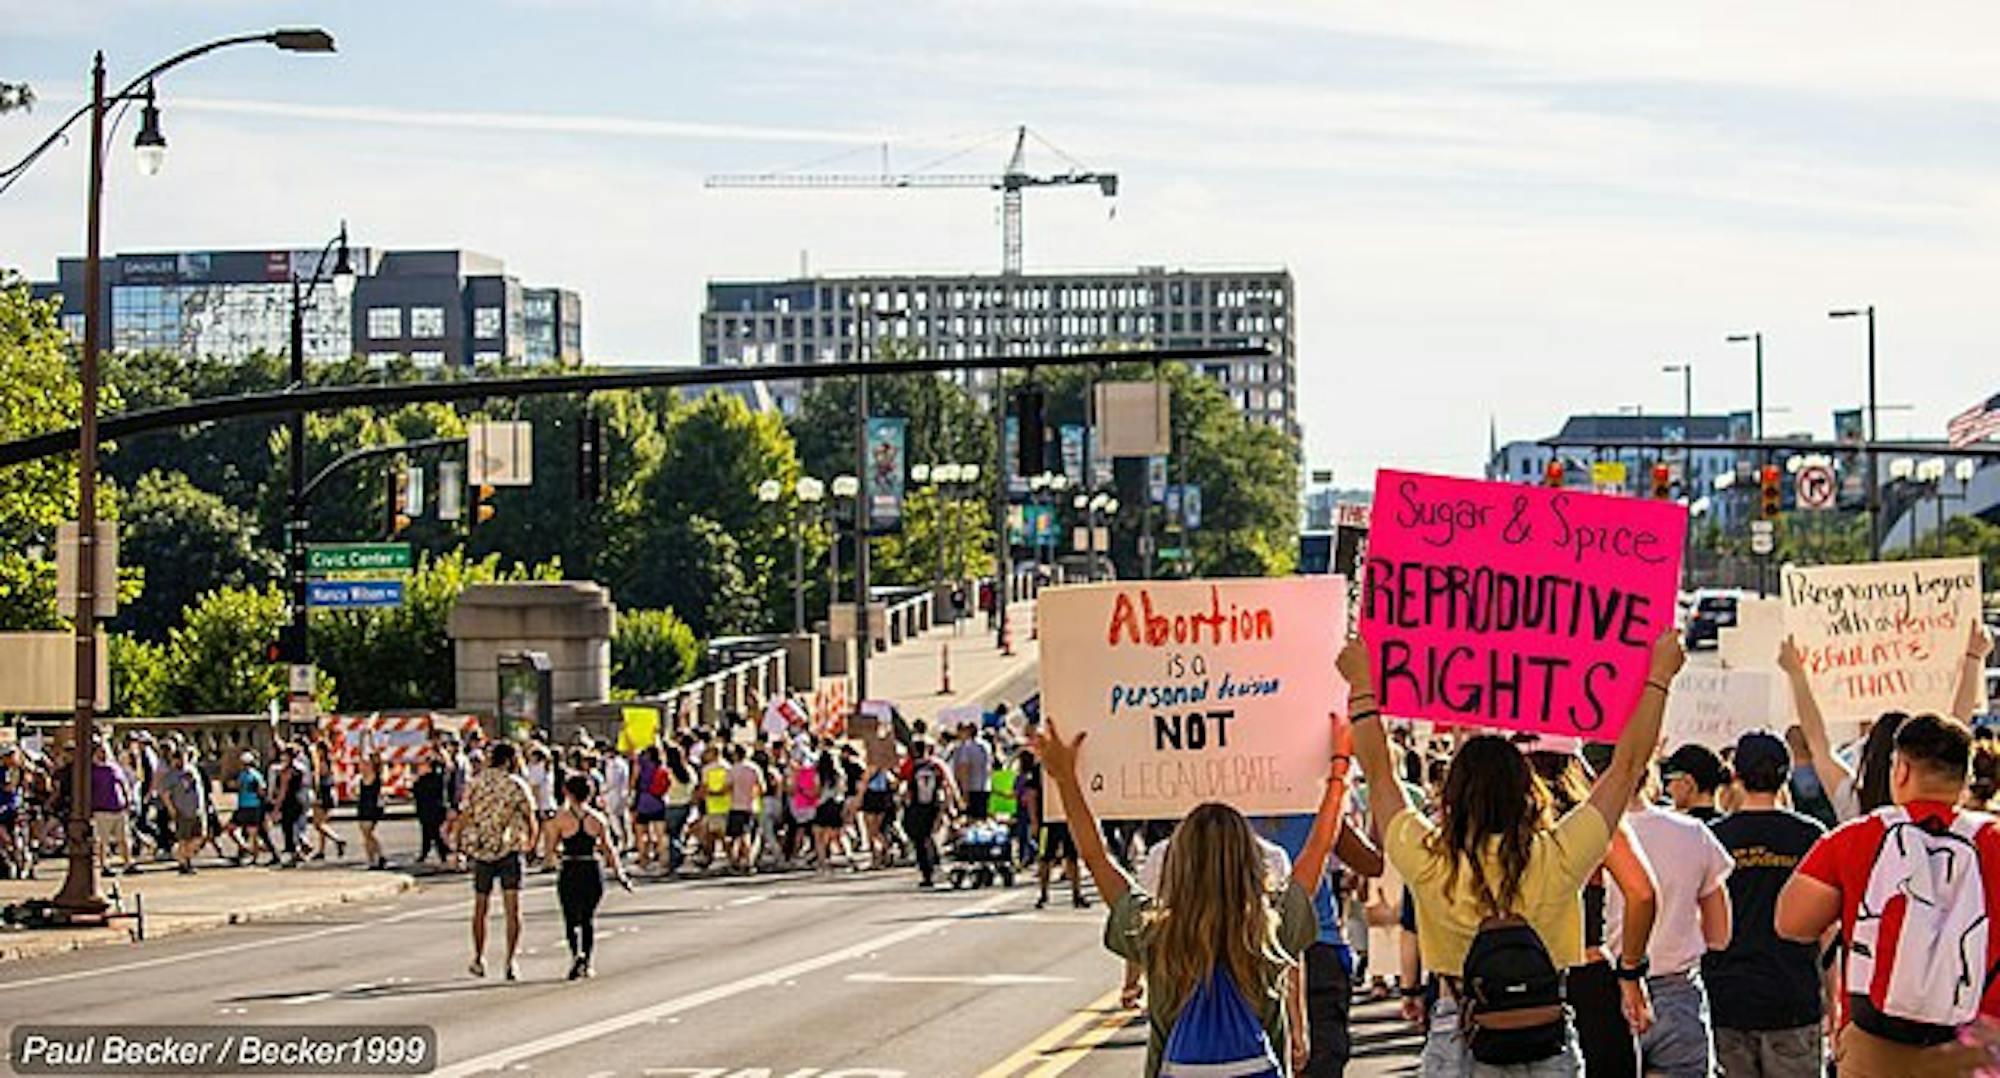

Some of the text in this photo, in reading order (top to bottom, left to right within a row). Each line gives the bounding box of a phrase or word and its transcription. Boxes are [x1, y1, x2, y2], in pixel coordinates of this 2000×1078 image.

[1397, 481, 1669, 564] Sugar & Spice
[311, 551, 347, 567] Civic
[1108, 585, 1274, 647] Abortion
[1364, 557, 1651, 648] REPRODUTIVE
[1167, 652, 1207, 678] is a
[1111, 679, 1209, 714] personal
[1379, 639, 1618, 733] RIGHTS
[1155, 710, 1235, 750] NOT
[1090, 773, 1104, 793] a
